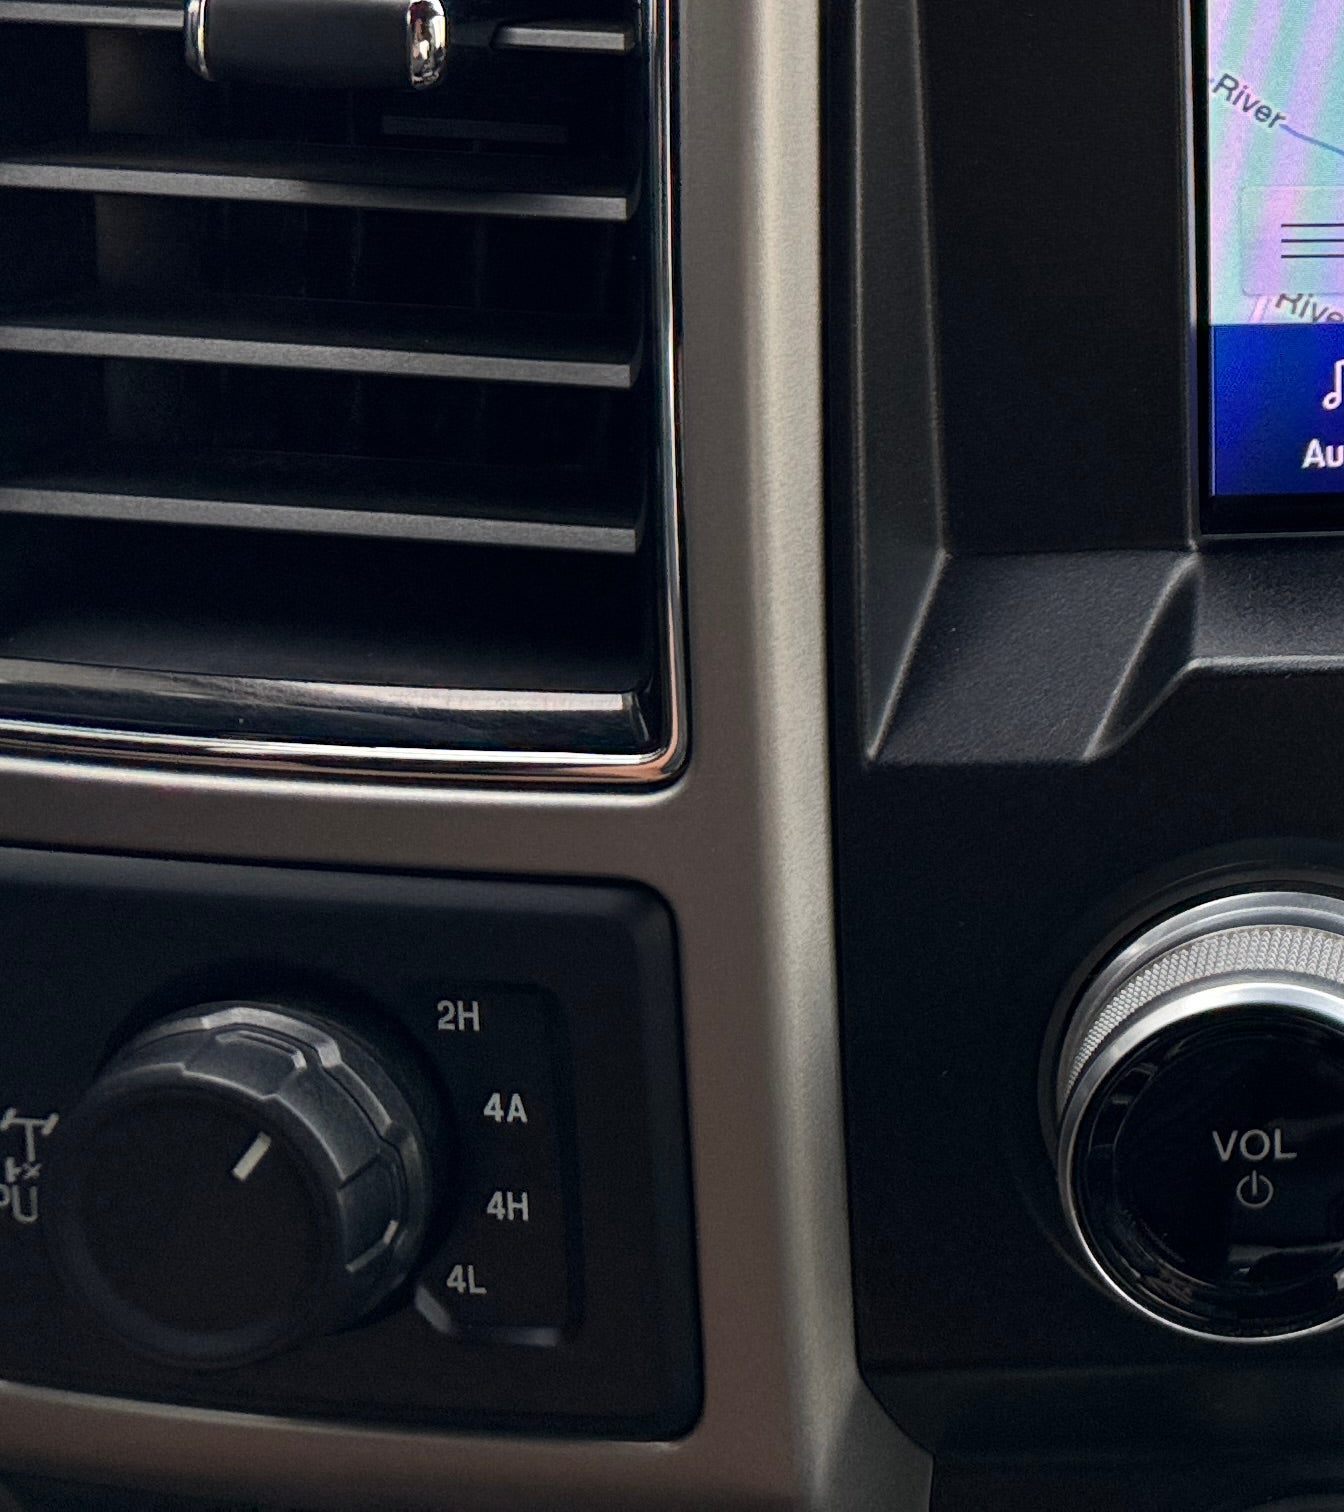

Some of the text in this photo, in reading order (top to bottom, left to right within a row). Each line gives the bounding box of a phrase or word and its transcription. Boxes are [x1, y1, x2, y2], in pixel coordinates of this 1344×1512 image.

[1212, 73, 1286, 128] River
[437, 999, 481, 1033] 2H
[484, 1093, 528, 1124] 4A
[1212, 1128, 1298, 1163] VOL
[487, 1191, 530, 1221] 4H
[446, 1264, 487, 1295] 4L
